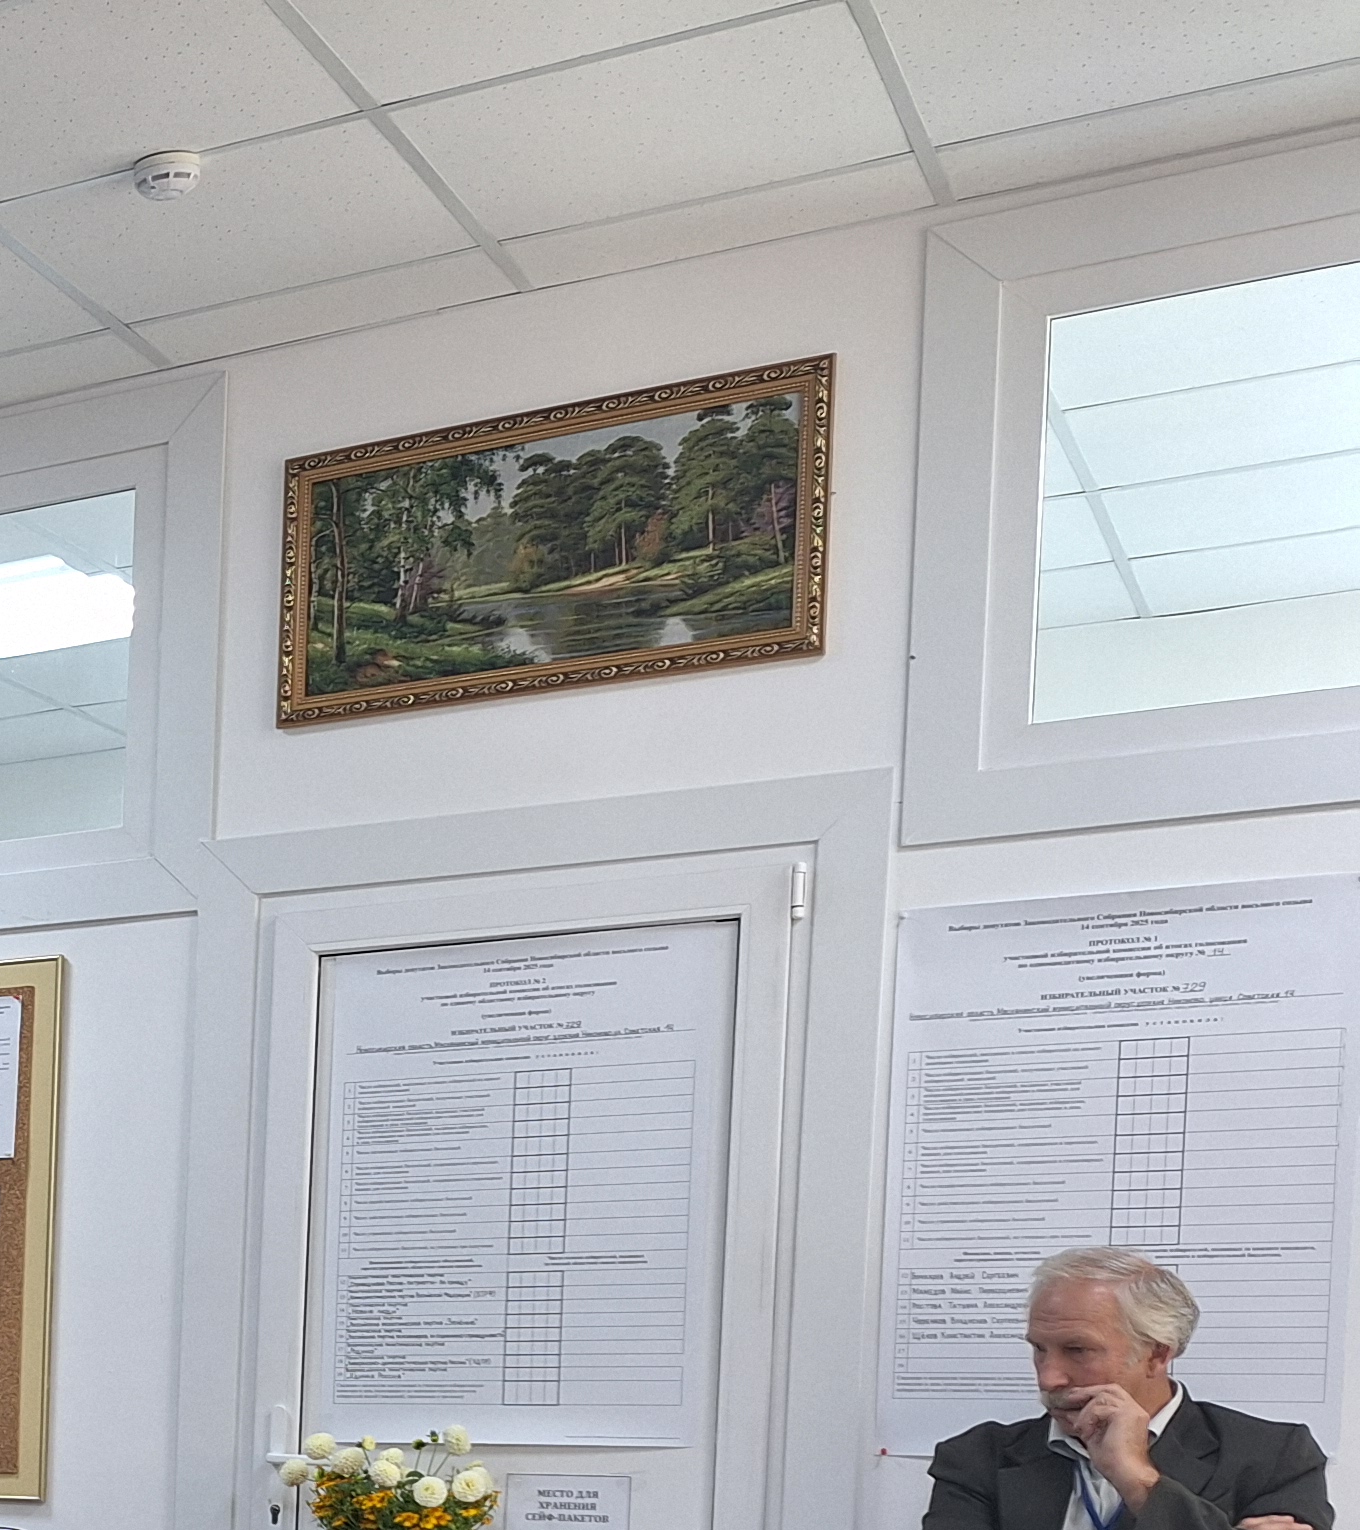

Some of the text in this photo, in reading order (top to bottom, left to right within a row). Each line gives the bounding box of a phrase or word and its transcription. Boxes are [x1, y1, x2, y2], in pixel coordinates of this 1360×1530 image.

[537, 1490, 599, 1499] МЕСТО ДЛЯ
[538, 1501, 597, 1511] ХРАНЕНИЯ
[525, 1511, 610, 1523] СЕЙФ-ПАКЕТОВ
